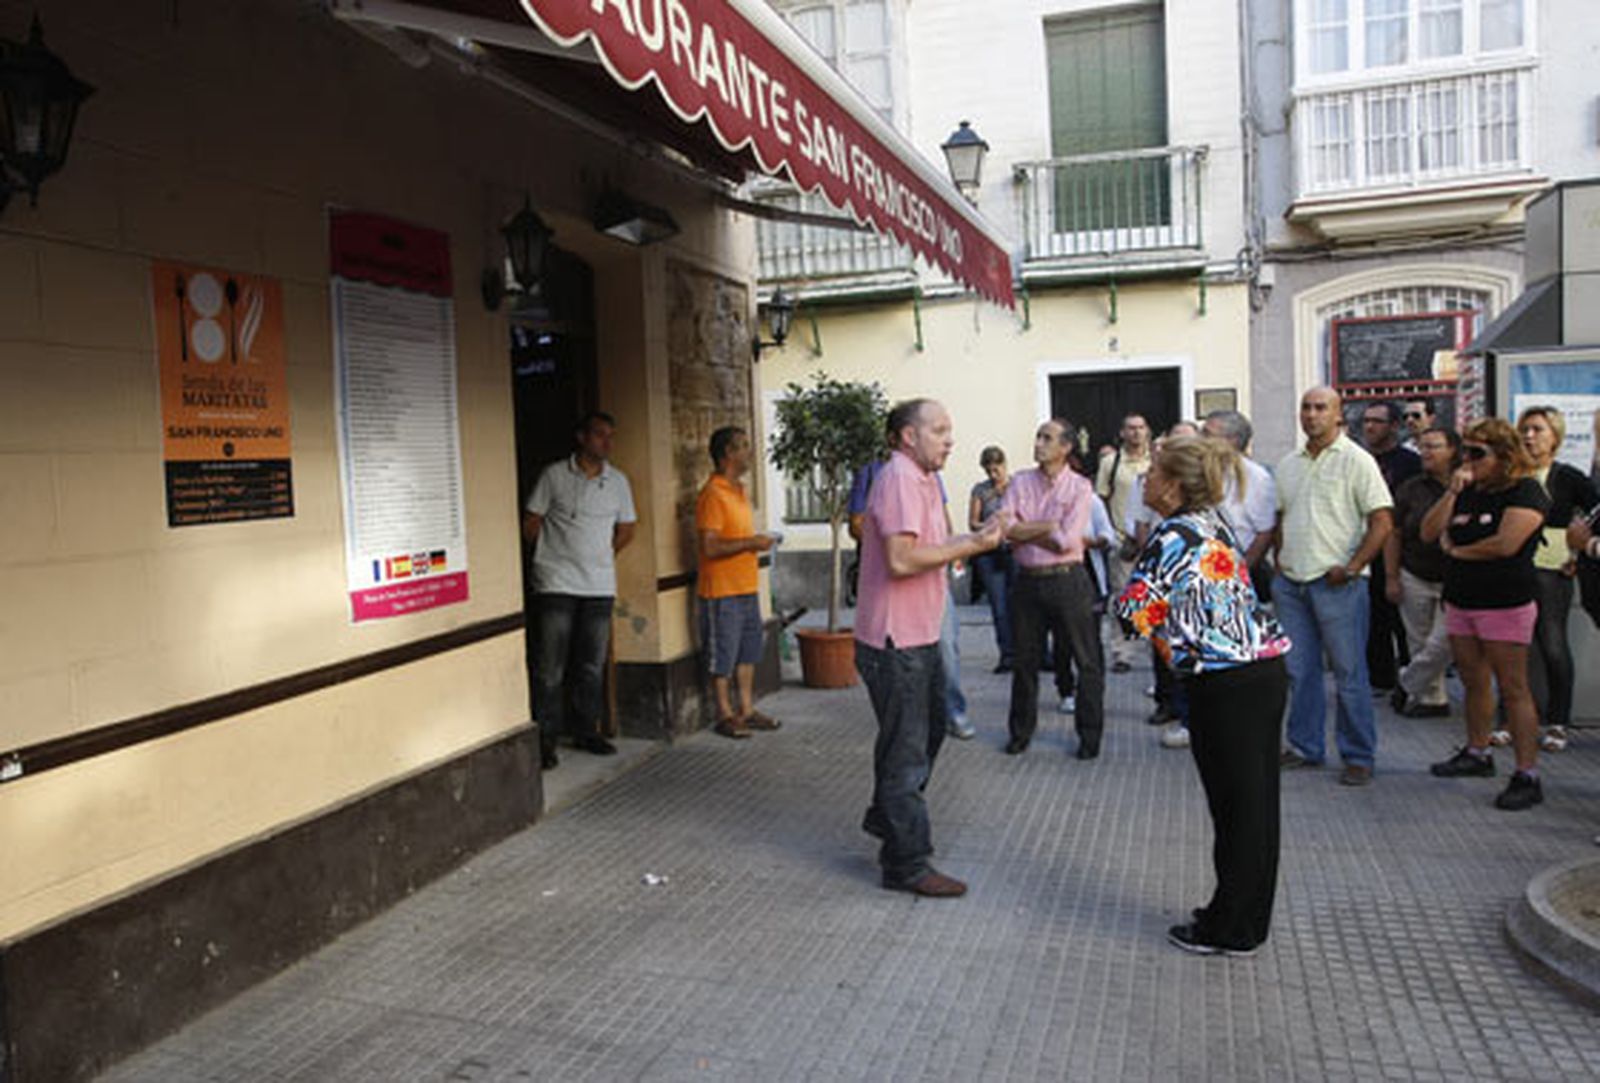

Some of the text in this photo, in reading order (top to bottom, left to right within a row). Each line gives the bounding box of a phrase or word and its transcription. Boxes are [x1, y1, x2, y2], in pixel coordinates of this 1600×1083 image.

[795, 100, 849, 185] SAN
[167, 425, 194, 438] SAN
[196, 425, 260, 439] FRANCISCO
